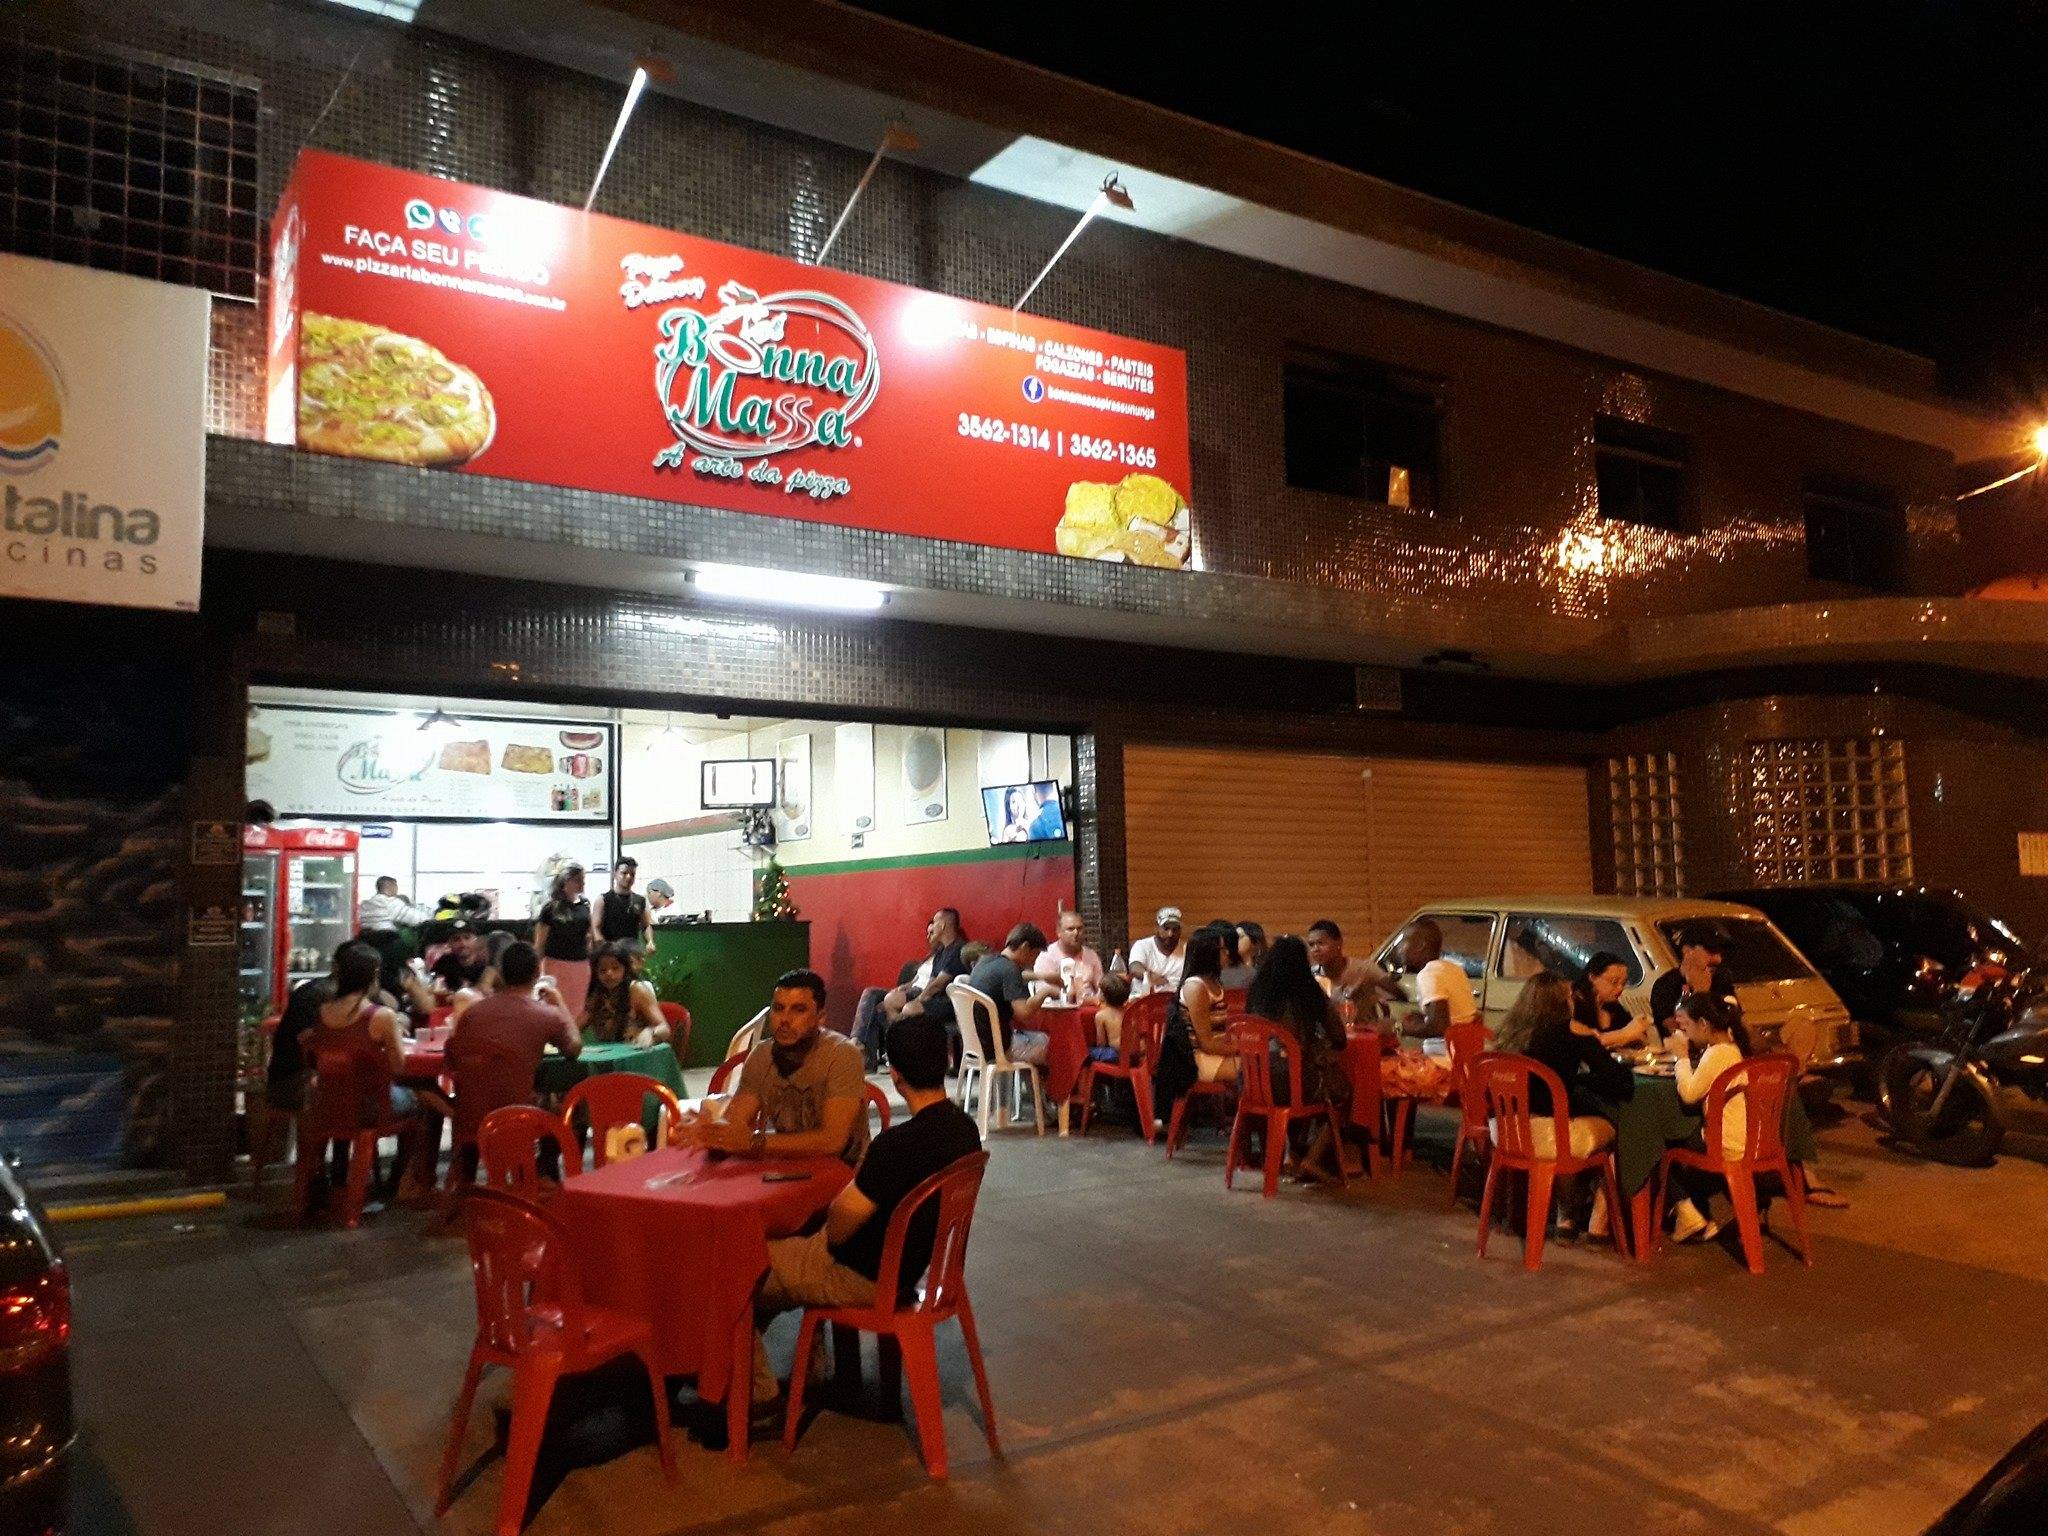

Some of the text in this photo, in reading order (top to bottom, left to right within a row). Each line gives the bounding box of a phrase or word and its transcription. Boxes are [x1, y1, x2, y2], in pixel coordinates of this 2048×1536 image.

[344, 224, 458, 266] FAÇA SEU
[1110, 354, 1154, 379] PASTEIS
[957, 412, 1157, 469] 3562-1314 3562-1365
[653, 441, 850, 498] A arte da pizza
